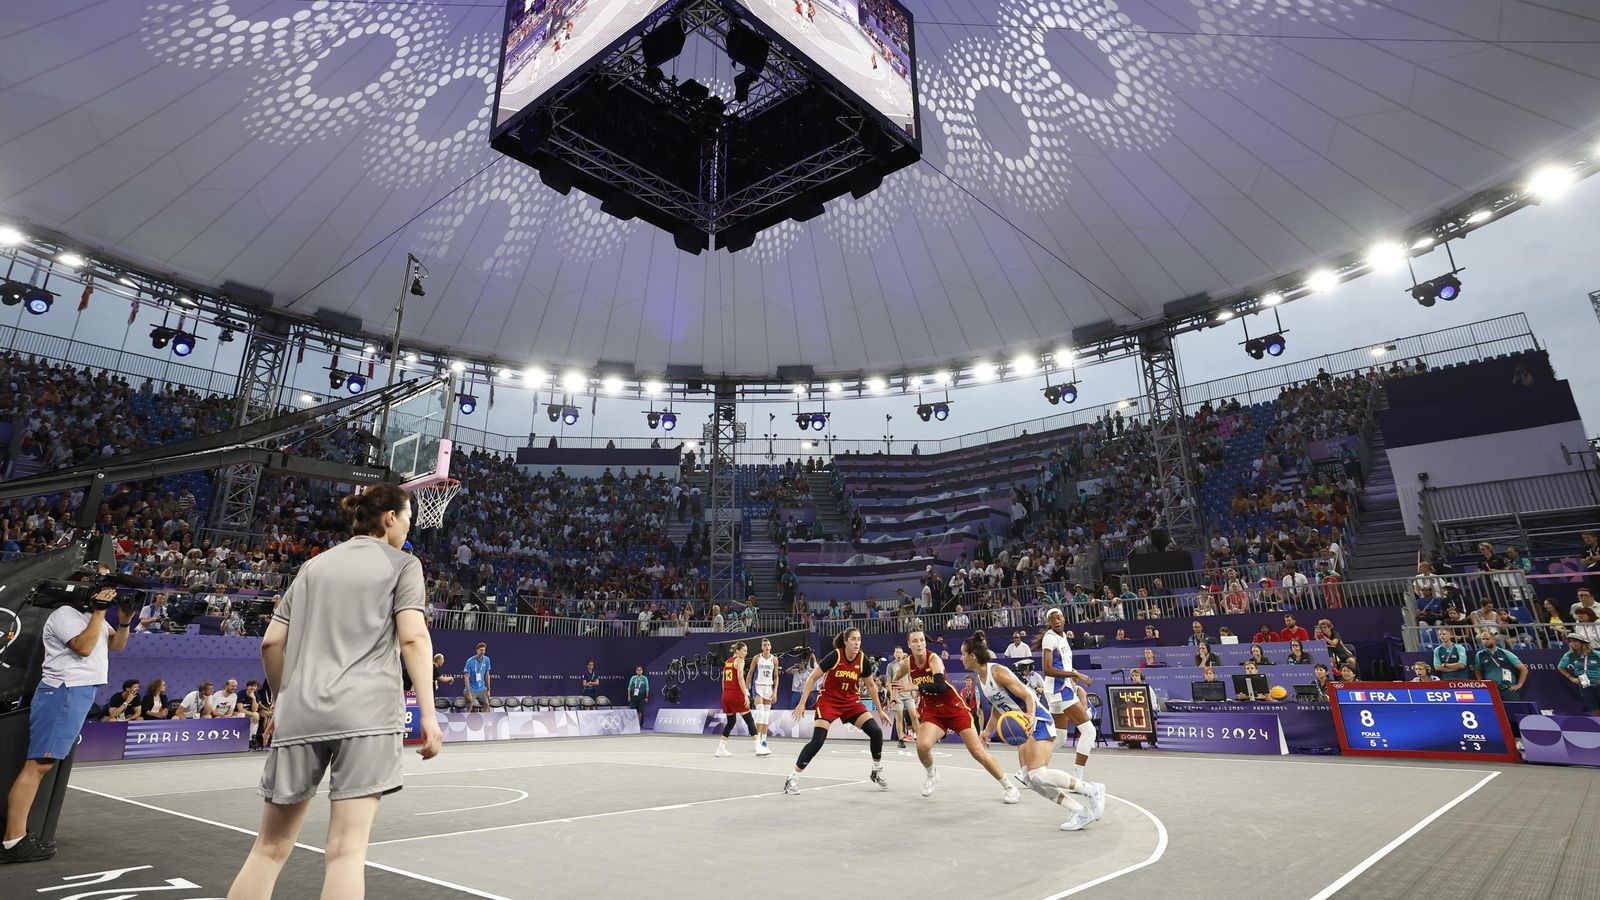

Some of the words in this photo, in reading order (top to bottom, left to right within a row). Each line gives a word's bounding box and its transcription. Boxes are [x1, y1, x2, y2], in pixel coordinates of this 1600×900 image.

[763, 670, 771, 678] 12
[841, 682, 849, 691] 11
[1119, 691, 1145, 703] 4:45
[1369, 692, 1397, 702] FRA
[1426, 691, 1452, 702] ESP
[404, 711, 413, 724] 8
[1126, 707, 1147, 728] 10
[1359, 709, 1375, 728] 8
[1461, 710, 1479, 730] 8
[1463, 733, 1485, 741] FOULS
[1370, 739, 1377, 748] 5
[1473, 742, 1481, 751] 3
